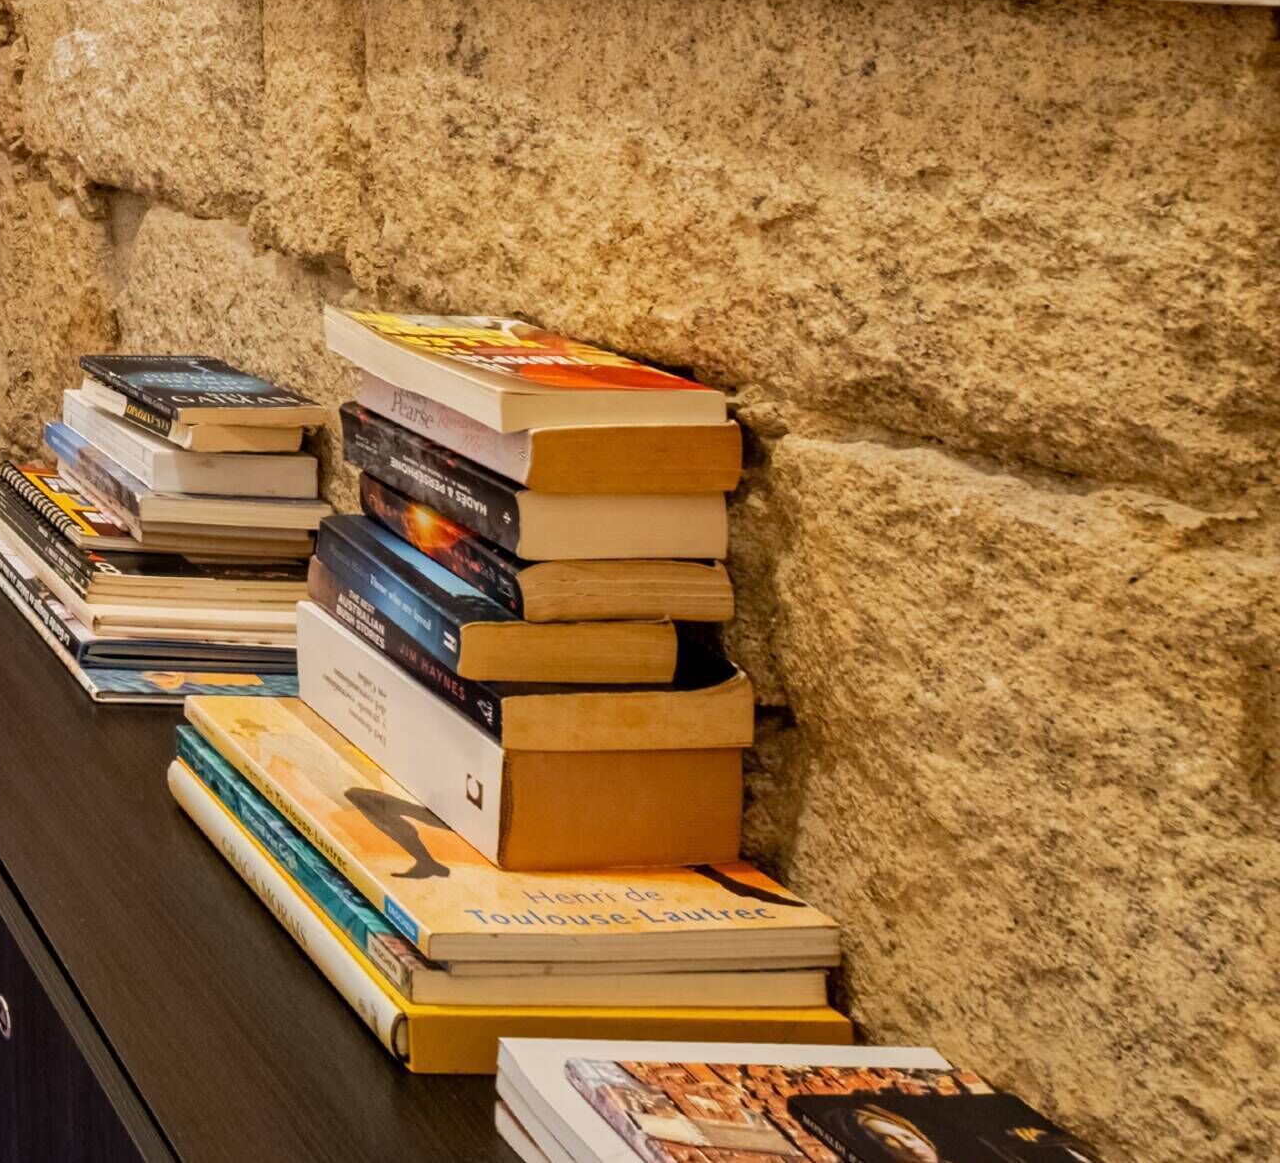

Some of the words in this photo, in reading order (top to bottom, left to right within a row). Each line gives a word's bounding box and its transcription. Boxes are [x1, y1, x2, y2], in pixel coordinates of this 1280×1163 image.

[391, 390, 434, 429] Pearse
[337, 593, 385, 637] AUSTRALIAN
[349, 589, 361, 604] THE
[336, 604, 356, 627] BUSH
[356, 616, 385, 651] STORIES
[399, 643, 418, 663] JIM
[421, 656, 466, 701] HAYNES
[275, 790, 348, 873] Toulouse-Lautrec
[523, 887, 618, 906] Henri
[624, 886, 665, 904] de
[464, 905, 778, 927] Toulouse-Lautrec
[370, 941, 398, 975] TASCHEN
